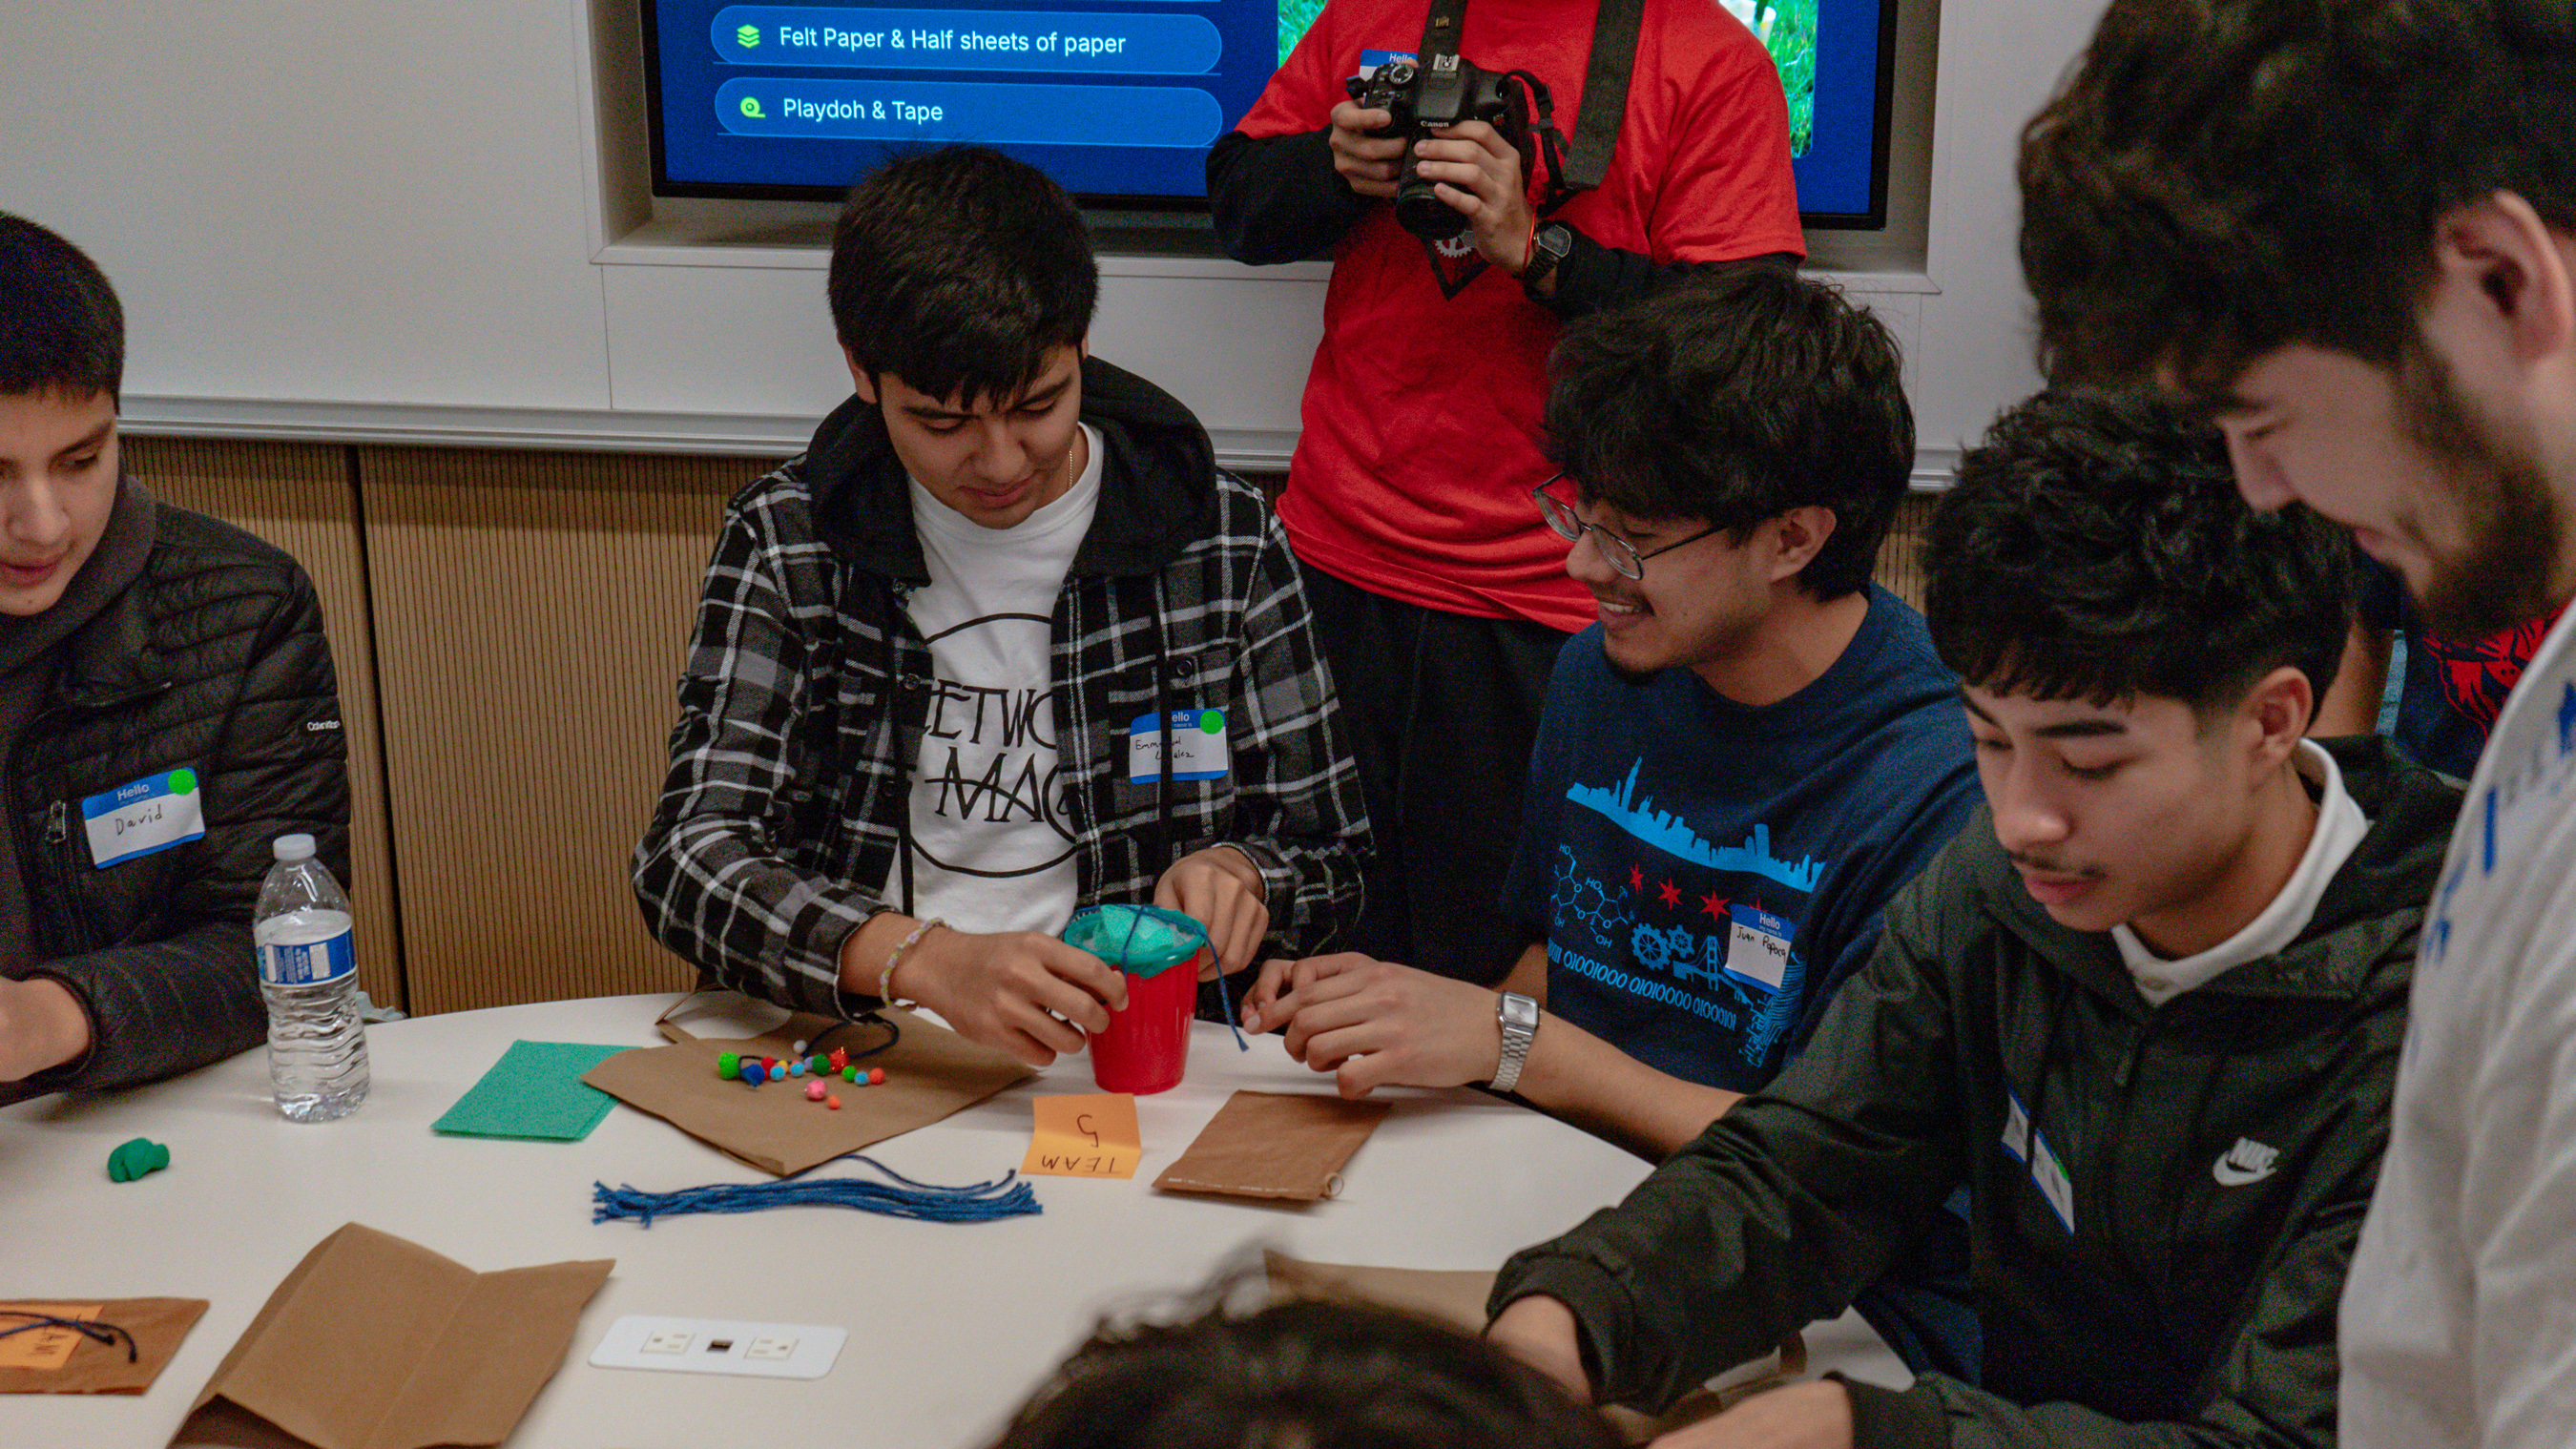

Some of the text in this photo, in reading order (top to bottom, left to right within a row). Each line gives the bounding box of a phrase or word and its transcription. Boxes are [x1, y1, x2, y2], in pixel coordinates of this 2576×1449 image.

[779, 26, 1127, 56] Felt Paper & Half sheets of paper
[783, 97, 944, 123] Playdoh & Tape
[1172, 712, 1191, 722] ello
[116, 784, 150, 801] Hello
[115, 803, 162, 836] David
[1759, 913, 1780, 930] Hello
[1736, 925, 1755, 942] Juan
[1076, 1114, 1099, 1149] 5
[1041, 1154, 1122, 1174] TEAM
